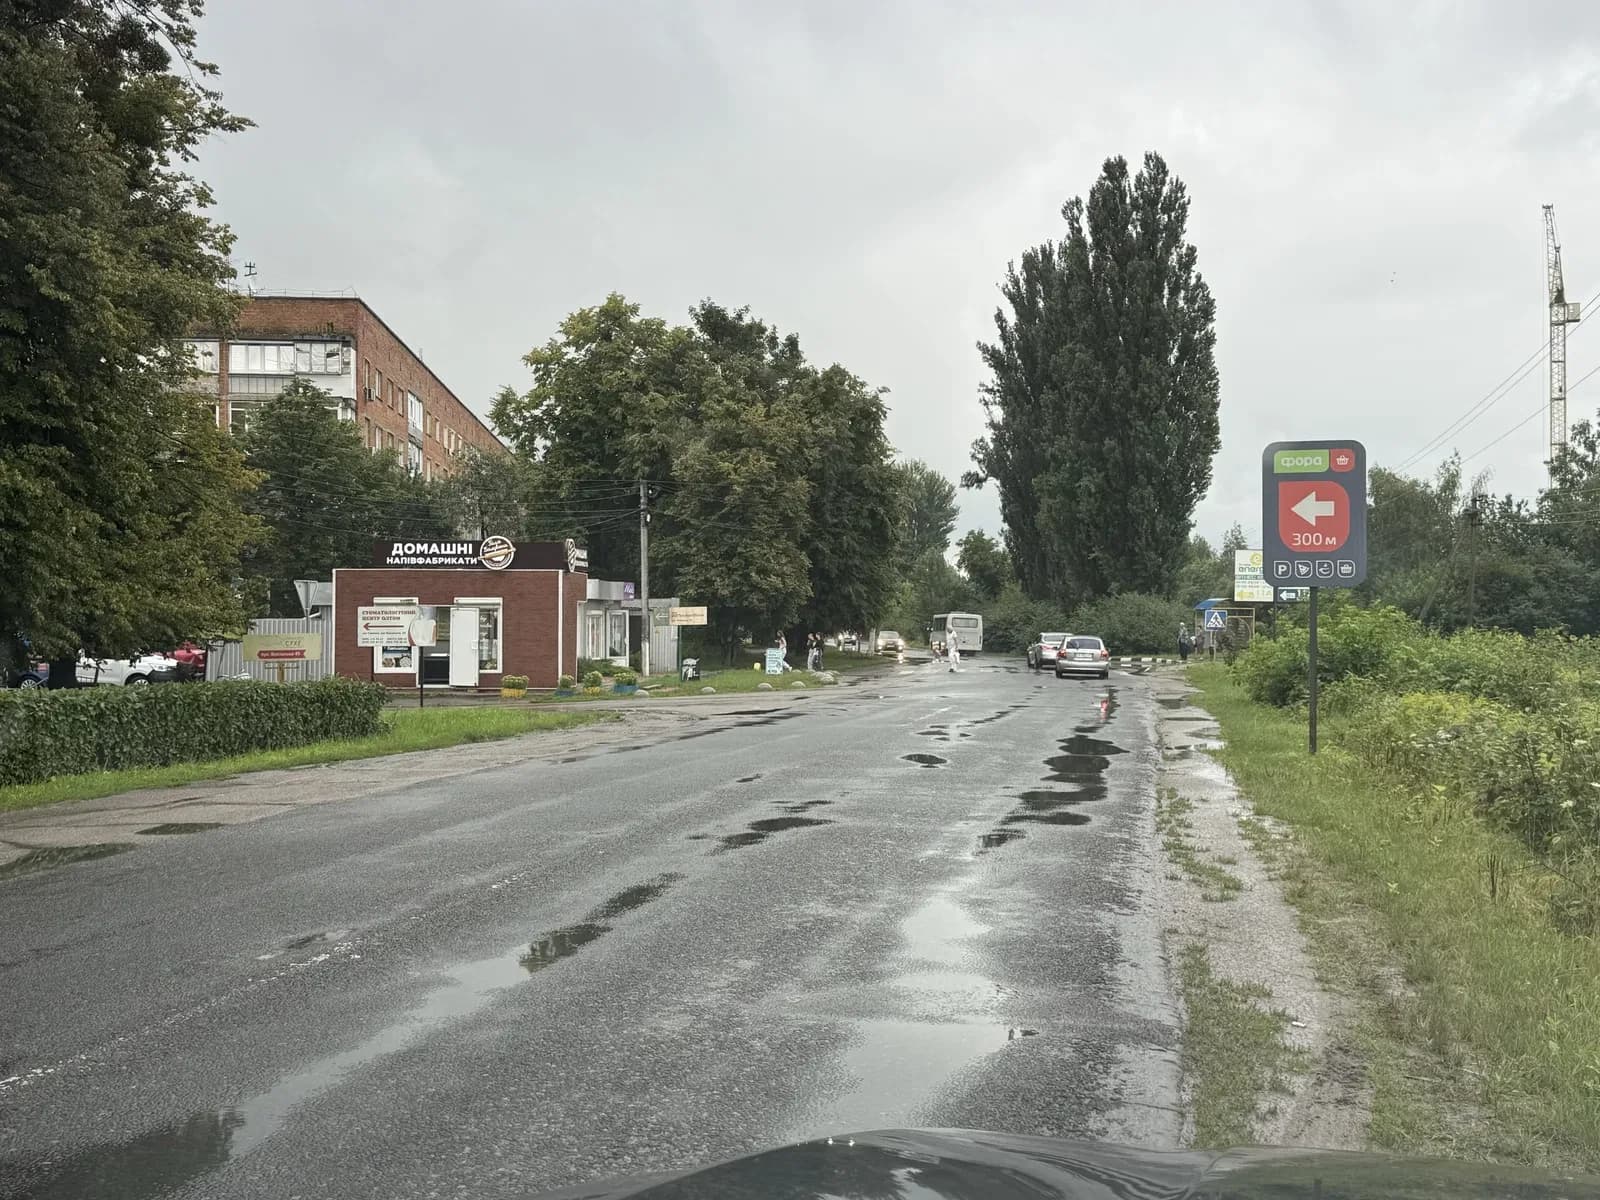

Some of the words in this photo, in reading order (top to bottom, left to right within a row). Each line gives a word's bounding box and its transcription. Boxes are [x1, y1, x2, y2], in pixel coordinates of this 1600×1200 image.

[1281, 456, 1322, 468] фора
[1292, 533, 1322, 546] 300
[392, 543, 473, 556] ДОМАШНІ
[386, 557, 478, 565] НАПІВФАБРИКАТИ
